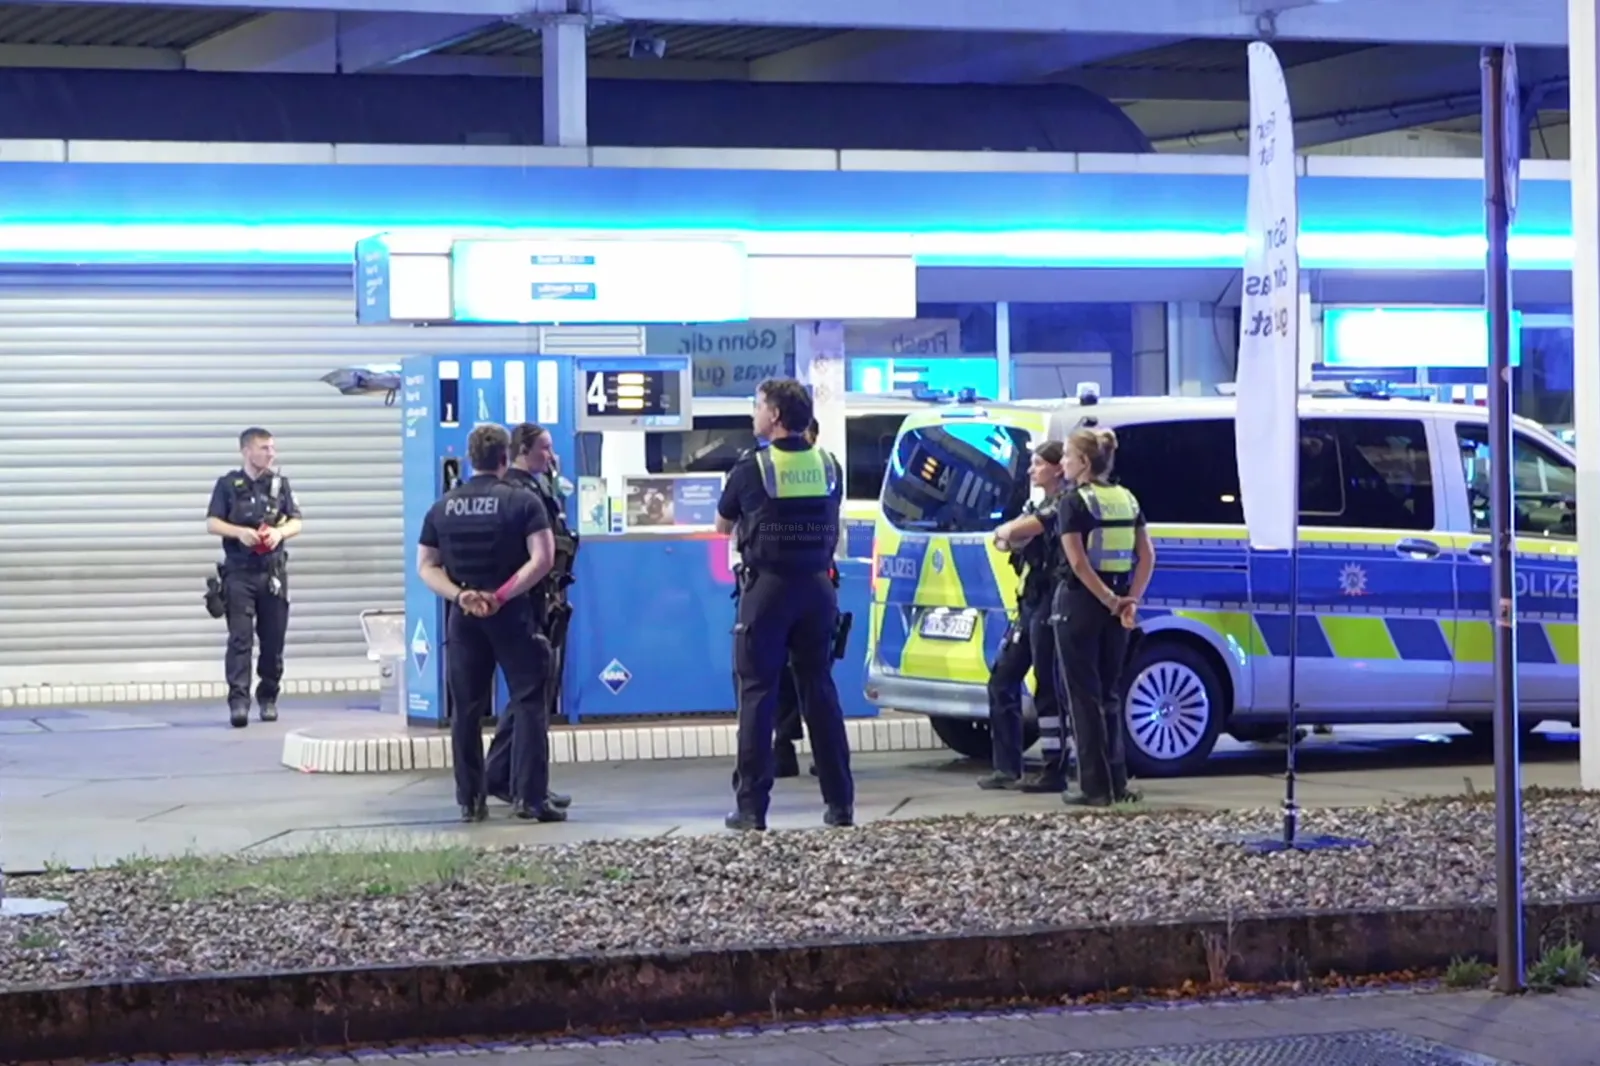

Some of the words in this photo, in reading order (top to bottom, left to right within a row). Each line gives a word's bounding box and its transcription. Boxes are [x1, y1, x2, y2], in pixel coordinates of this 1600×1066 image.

[587, 371, 607, 412] 4
[780, 467, 822, 485] POLIZEI
[445, 496, 499, 517] POLIZEI
[879, 556, 917, 579] POLIZEI
[1515, 571, 1578, 599] OLIZE
